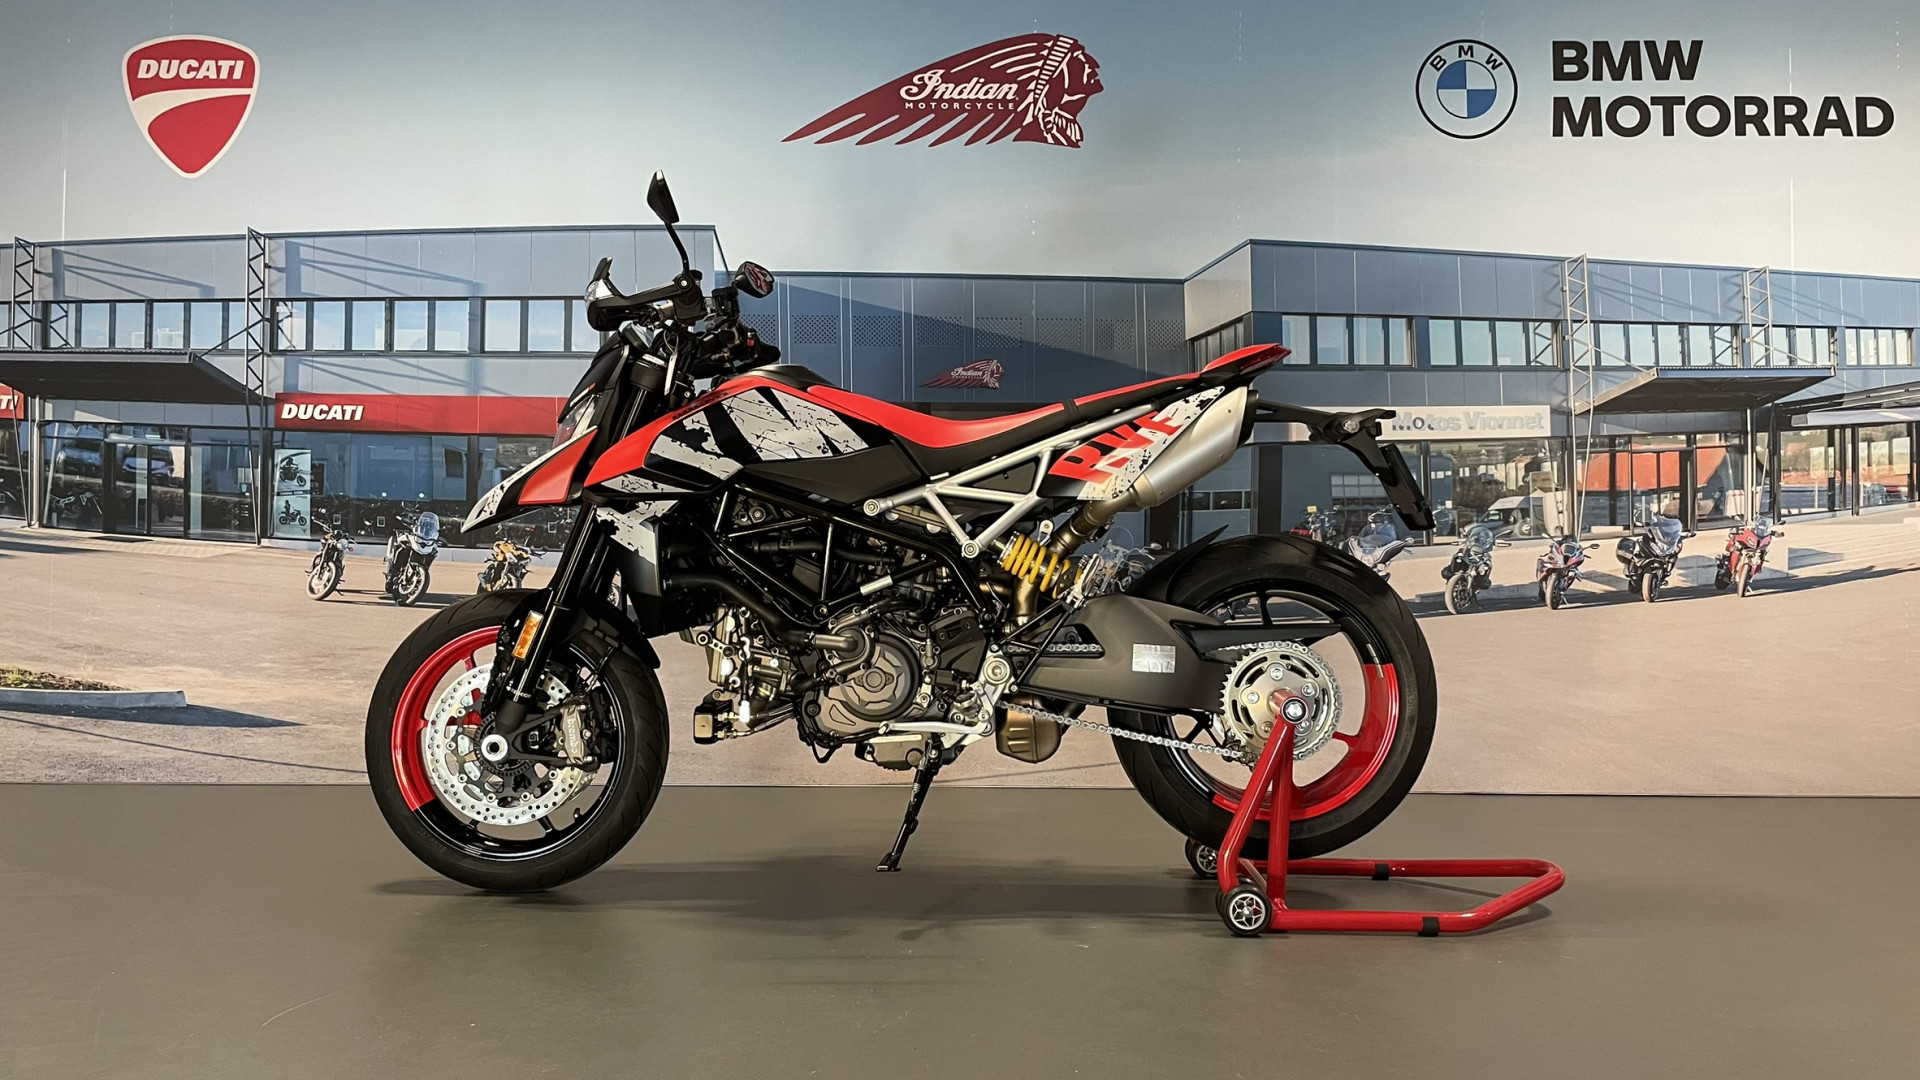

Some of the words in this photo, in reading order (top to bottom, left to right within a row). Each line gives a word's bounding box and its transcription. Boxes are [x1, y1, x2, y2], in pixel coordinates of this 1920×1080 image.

[137, 59, 245, 79] DUCATI
[1429, 45, 1503, 72] BMW
[1552, 40, 1703, 81] BMW
[900, 69, 1019, 101] Indian
[905, 102, 1015, 110] MOTORCYCLE
[1552, 95, 1895, 138] MOTORRAD
[281, 403, 364, 421] DUCATI
[1392, 412, 1461, 432] Motos
[1462, 411, 1545, 430] Vionnet
